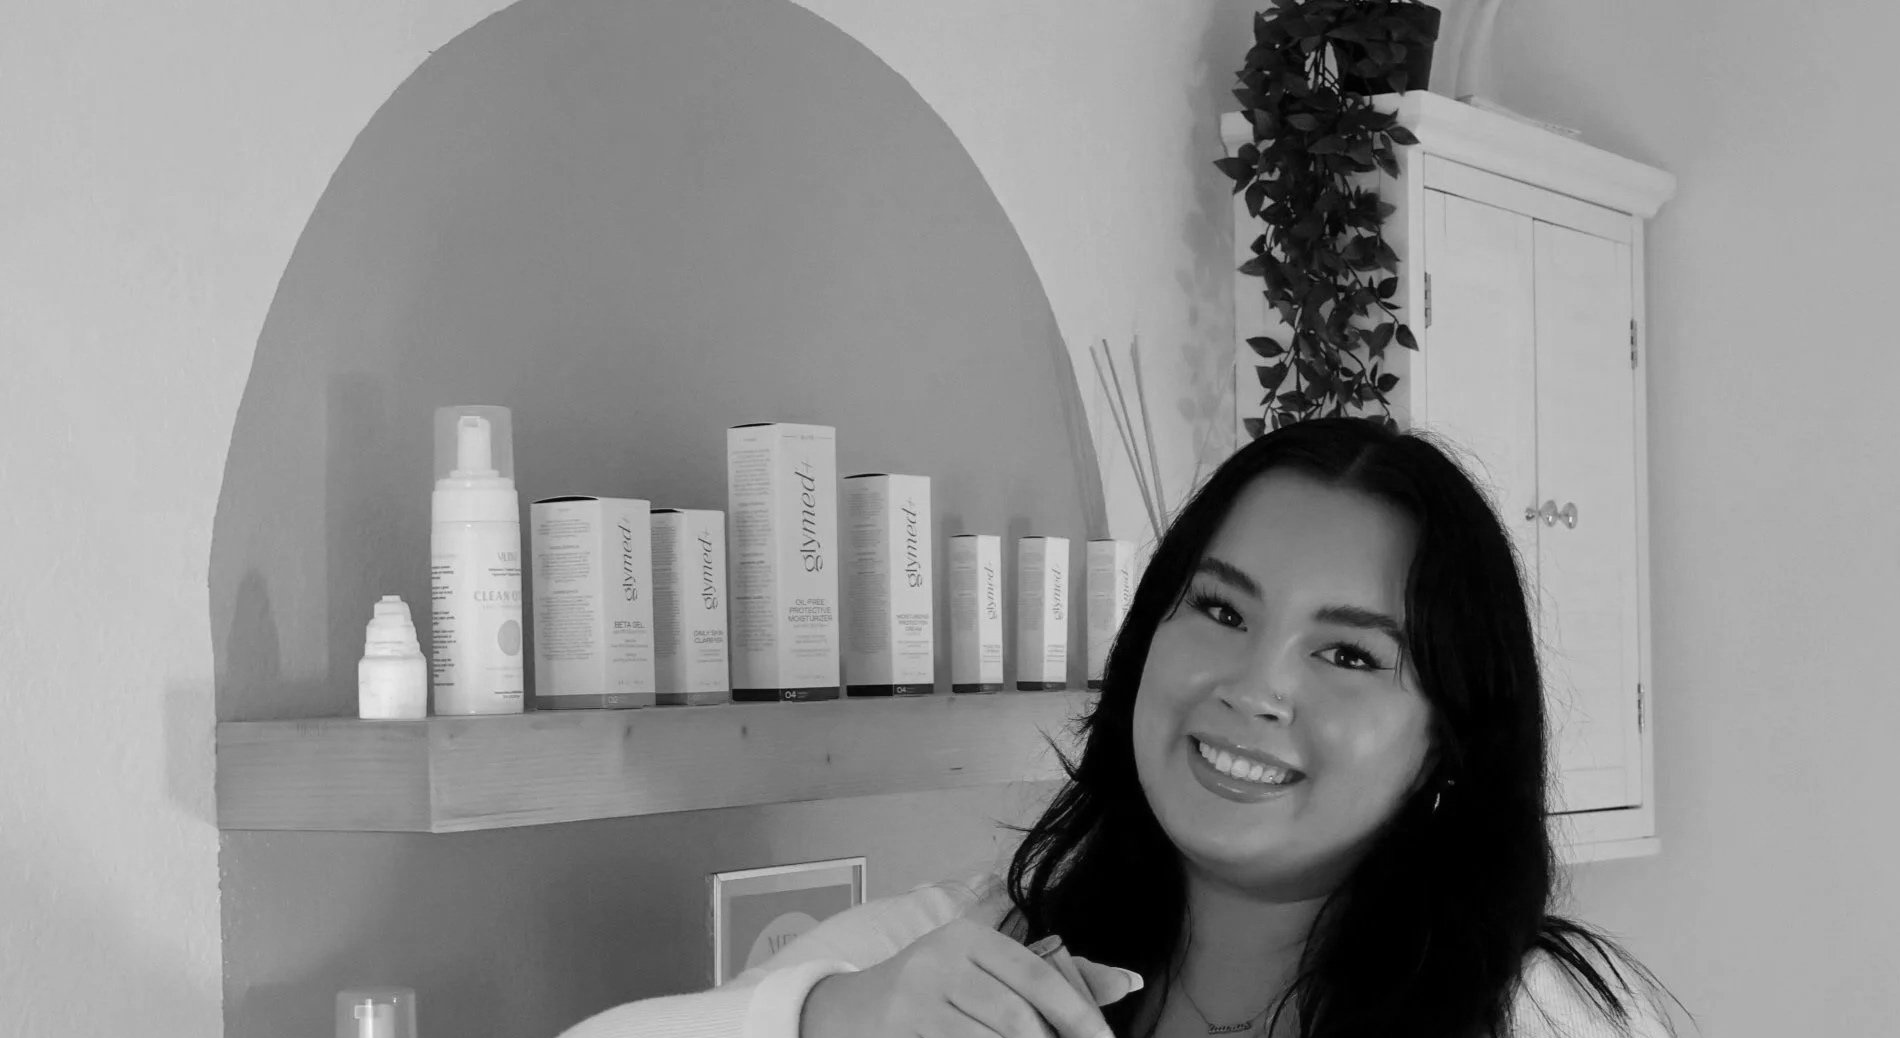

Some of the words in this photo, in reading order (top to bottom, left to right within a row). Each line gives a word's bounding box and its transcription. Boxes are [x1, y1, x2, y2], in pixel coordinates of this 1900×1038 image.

[474, 590, 510, 602] CLEAN
[789, 606, 832, 614] PROTECTIVE
[788, 614, 833, 622] MOISTURIZER
[614, 620, 631, 629] BETA
[896, 686, 907, 694] 04
[784, 690, 797, 700] 04
